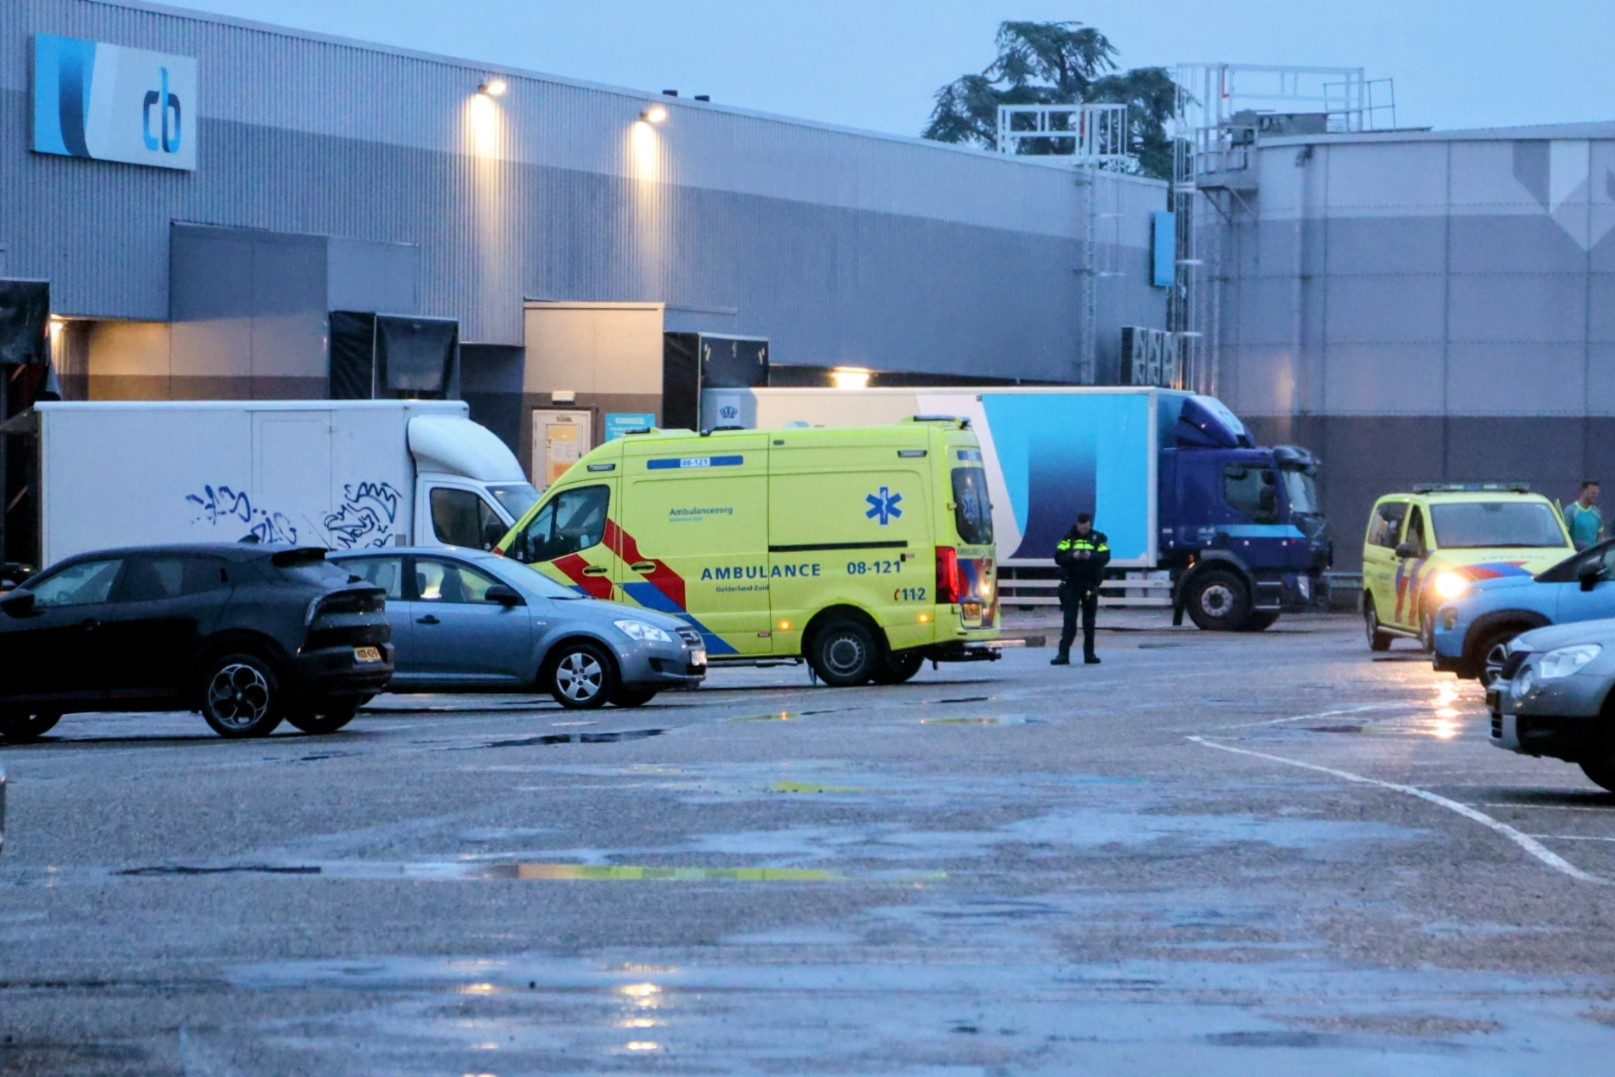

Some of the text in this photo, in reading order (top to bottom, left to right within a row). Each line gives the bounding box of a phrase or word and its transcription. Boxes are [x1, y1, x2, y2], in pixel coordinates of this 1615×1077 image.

[143, 66, 181, 153] cb
[682, 458, 708, 467] 08-121
[669, 506, 734, 516] Ambulancezorg
[701, 563, 821, 580] AMBULANCE
[847, 560, 900, 575] 08-121
[901, 587, 926, 600] 112
